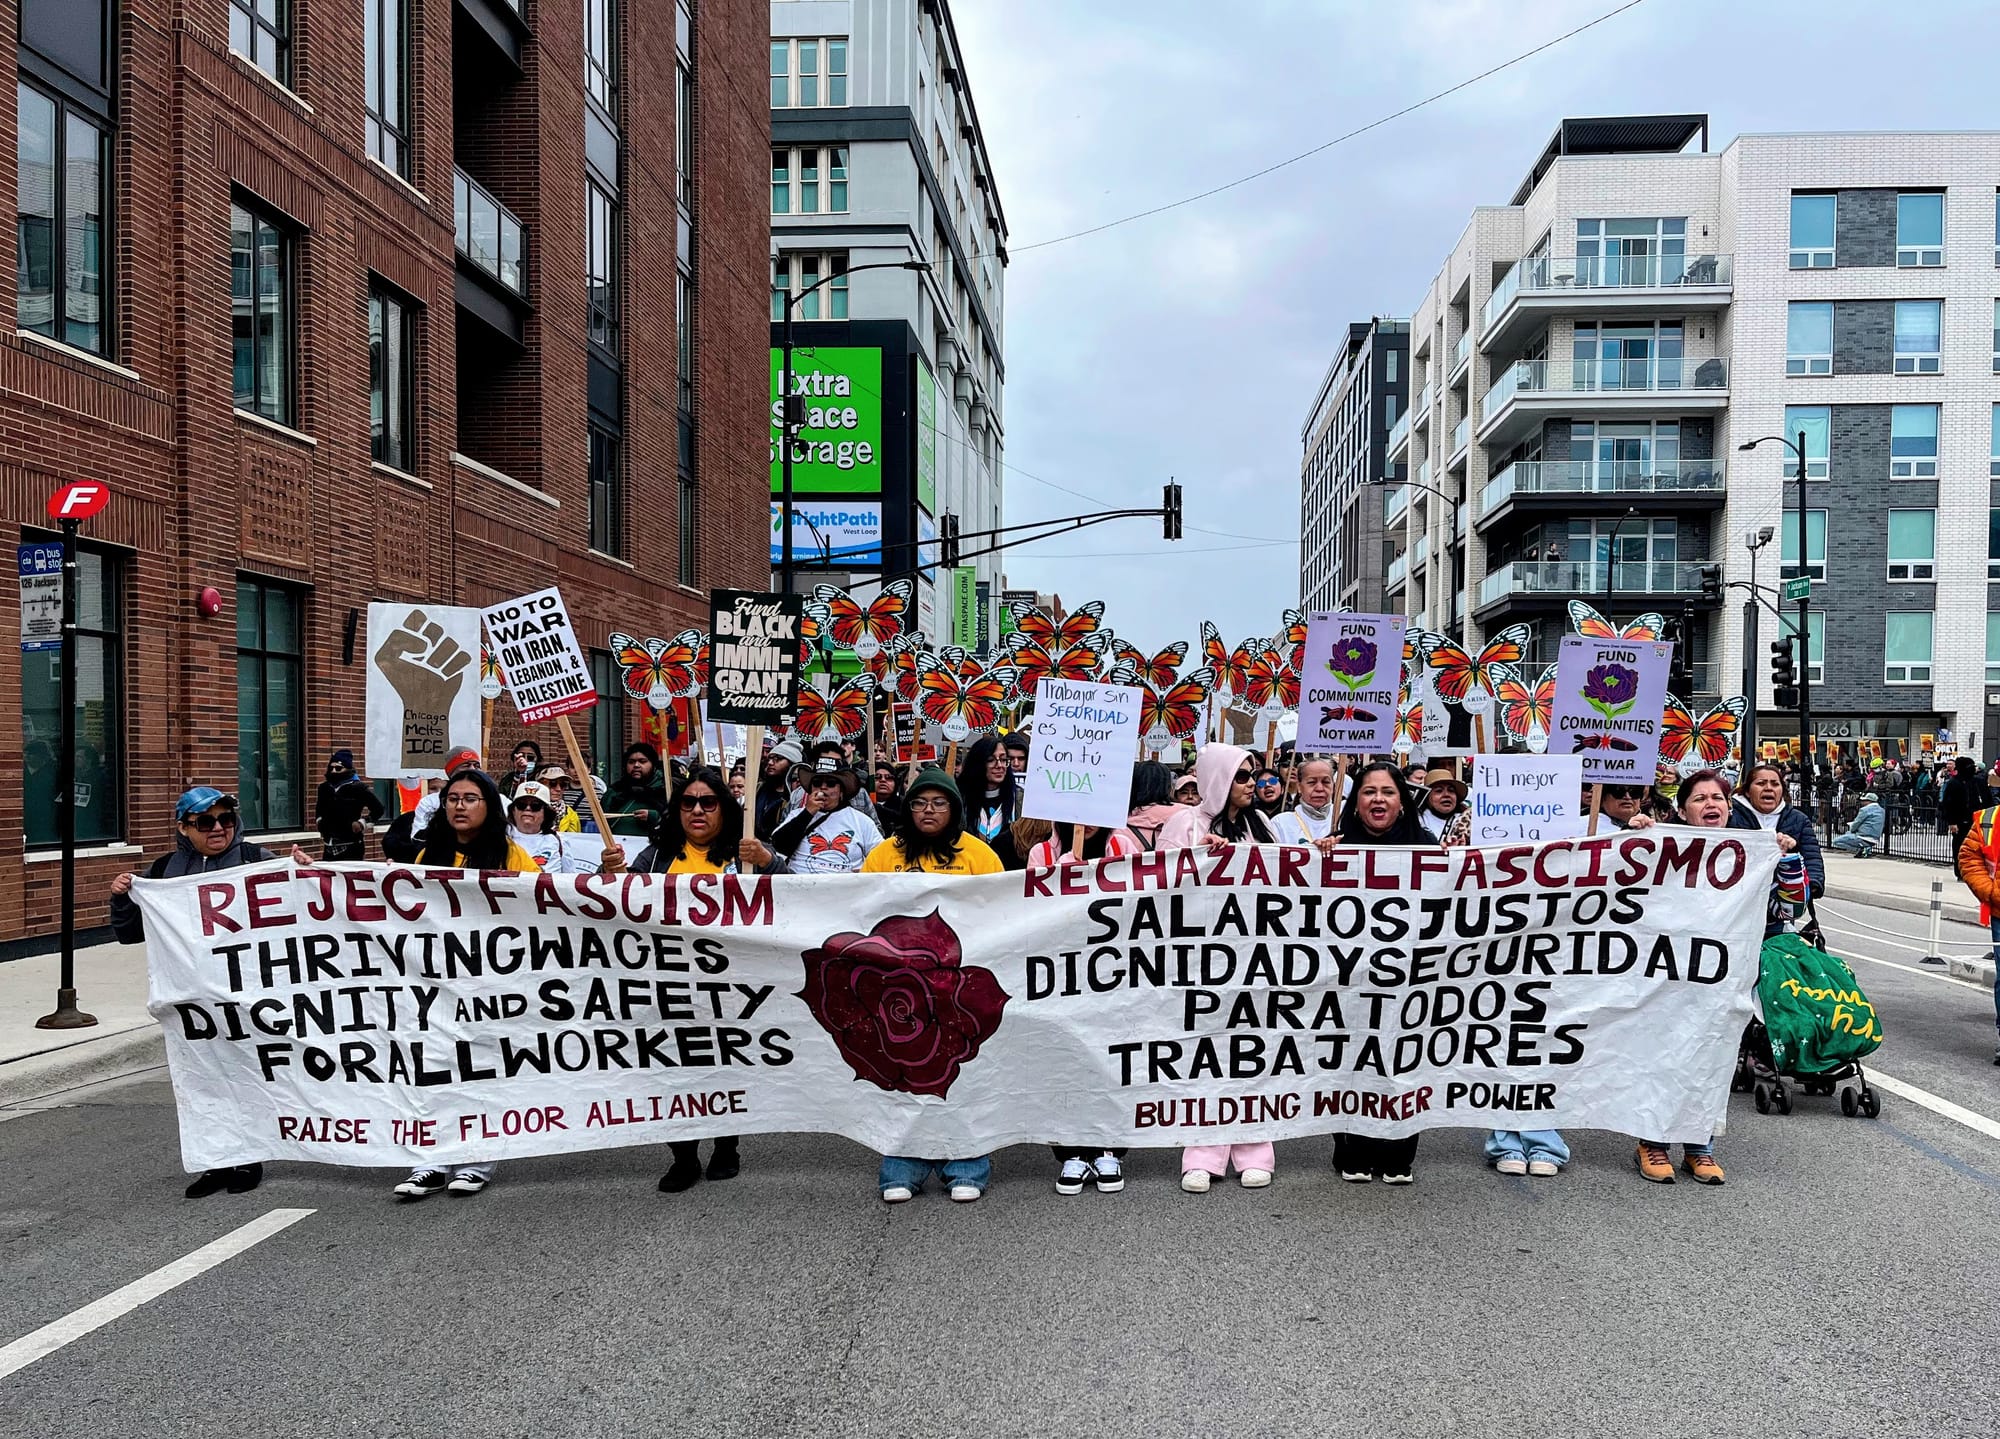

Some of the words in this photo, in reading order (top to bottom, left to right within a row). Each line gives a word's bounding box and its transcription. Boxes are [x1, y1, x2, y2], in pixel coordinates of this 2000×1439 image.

[778, 370, 850, 396] Extra
[771, 400, 858, 429] Sace
[60, 487, 98, 514] F
[46, 548, 60, 558] bus
[22, 579, 32, 588] 126
[487, 607, 520, 626] NO
[522, 596, 556, 612] TO
[732, 597, 782, 616] Fund
[491, 612, 566, 645] WAR
[716, 610, 796, 639] BLACK
[980, 602, 988, 640] Storage
[1341, 624, 1376, 636] FUND
[502, 646, 528, 668] ON
[529, 632, 571, 661] IRAN,
[739, 634, 771, 647] and
[715, 643, 793, 671] IMMI-
[1597, 651, 1636, 663] FUND
[508, 658, 568, 688] LEBANON,
[570, 656, 580, 670] &
[714, 670, 792, 694] GRANT
[517, 674, 588, 708] PALESTINE
[720, 689, 790, 708] Families
[1040, 678, 1098, 708] Trabajar
[1308, 689, 1392, 705] COMMUNITIES
[404, 709, 446, 726] Chicago
[522, 707, 551, 722] FRSO
[1046, 703, 1128, 724] SEGURIDAD
[1560, 716, 1654, 735] COMMUNITIES
[406, 724, 444, 736] Melts
[1038, 722, 1056, 736] es
[1319, 728, 1345, 740] NOT
[1348, 730, 1375, 740] WAR
[405, 738, 444, 754] ICE
[1081, 746, 1102, 766] tú
[1582, 758, 1602, 768] OT
[1604, 759, 1635, 770] WAR
[1512, 773, 1558, 790] mejor
[1476, 793, 1565, 822] Homenaje
[1482, 826, 1508, 839] es
[1520, 824, 1540, 840] la
[1024, 845, 1310, 897] RECHAZAR
[1320, 848, 1400, 890] EL
[1410, 836, 1747, 891] FASCISMO
[197, 868, 464, 936] REJECT
[478, 868, 774, 926] FASCISM
[1086, 893, 1410, 944] SALARIOS
[1419, 888, 1649, 940] JUSTOS
[528, 926, 730, 974] WAGES
[1026, 942, 1320, 1001] DIGNIDAD
[1328, 945, 1364, 986] Y
[1369, 931, 1729, 987] SEGURIDAD
[174, 985, 440, 1040] DIGNITY
[455, 994, 528, 1022] AND
[538, 977, 776, 1021] SAFETY
[1184, 989, 1346, 1031] PARA
[1360, 981, 1552, 1030] TODOS
[256, 1041, 384, 1083] FOR
[388, 1040, 496, 1087] ALL
[499, 1026, 794, 1078] WORKERS
[1109, 1024, 1588, 1086] TRABAJADORES
[278, 1116, 370, 1144] RAISE
[392, 1119, 436, 1147] THE
[459, 1106, 570, 1142] FLOOR
[586, 1090, 748, 1128] ALLIANCE
[1135, 1093, 1301, 1128] BUILDING
[1314, 1086, 1433, 1120] WORKER
[1446, 1082, 1556, 1110] POWER
